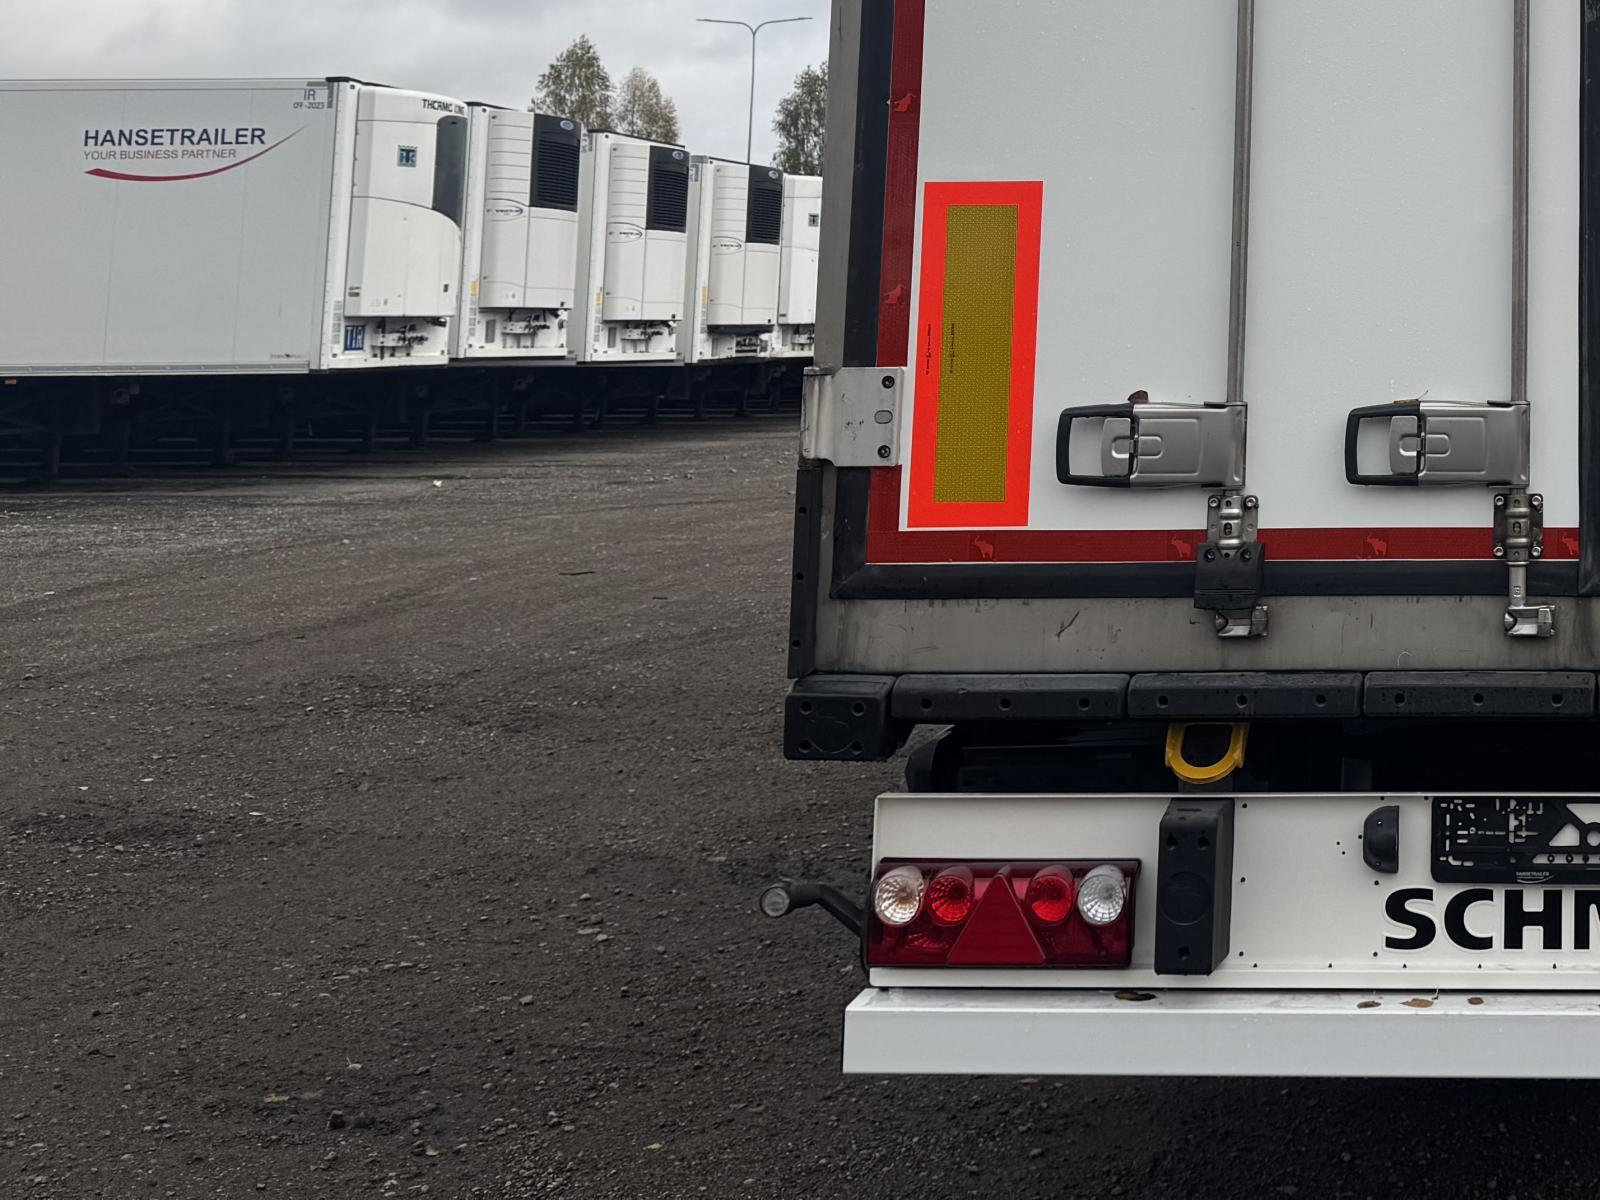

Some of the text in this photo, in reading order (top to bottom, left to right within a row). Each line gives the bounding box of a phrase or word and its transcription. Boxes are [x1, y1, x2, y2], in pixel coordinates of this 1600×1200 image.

[303, 88, 316, 101] IR
[84, 128, 266, 147] HANSETRAILER
[84, 148, 237, 160] YOUR BUSINESS PARTNER
[346, 326, 363, 348] TIR
